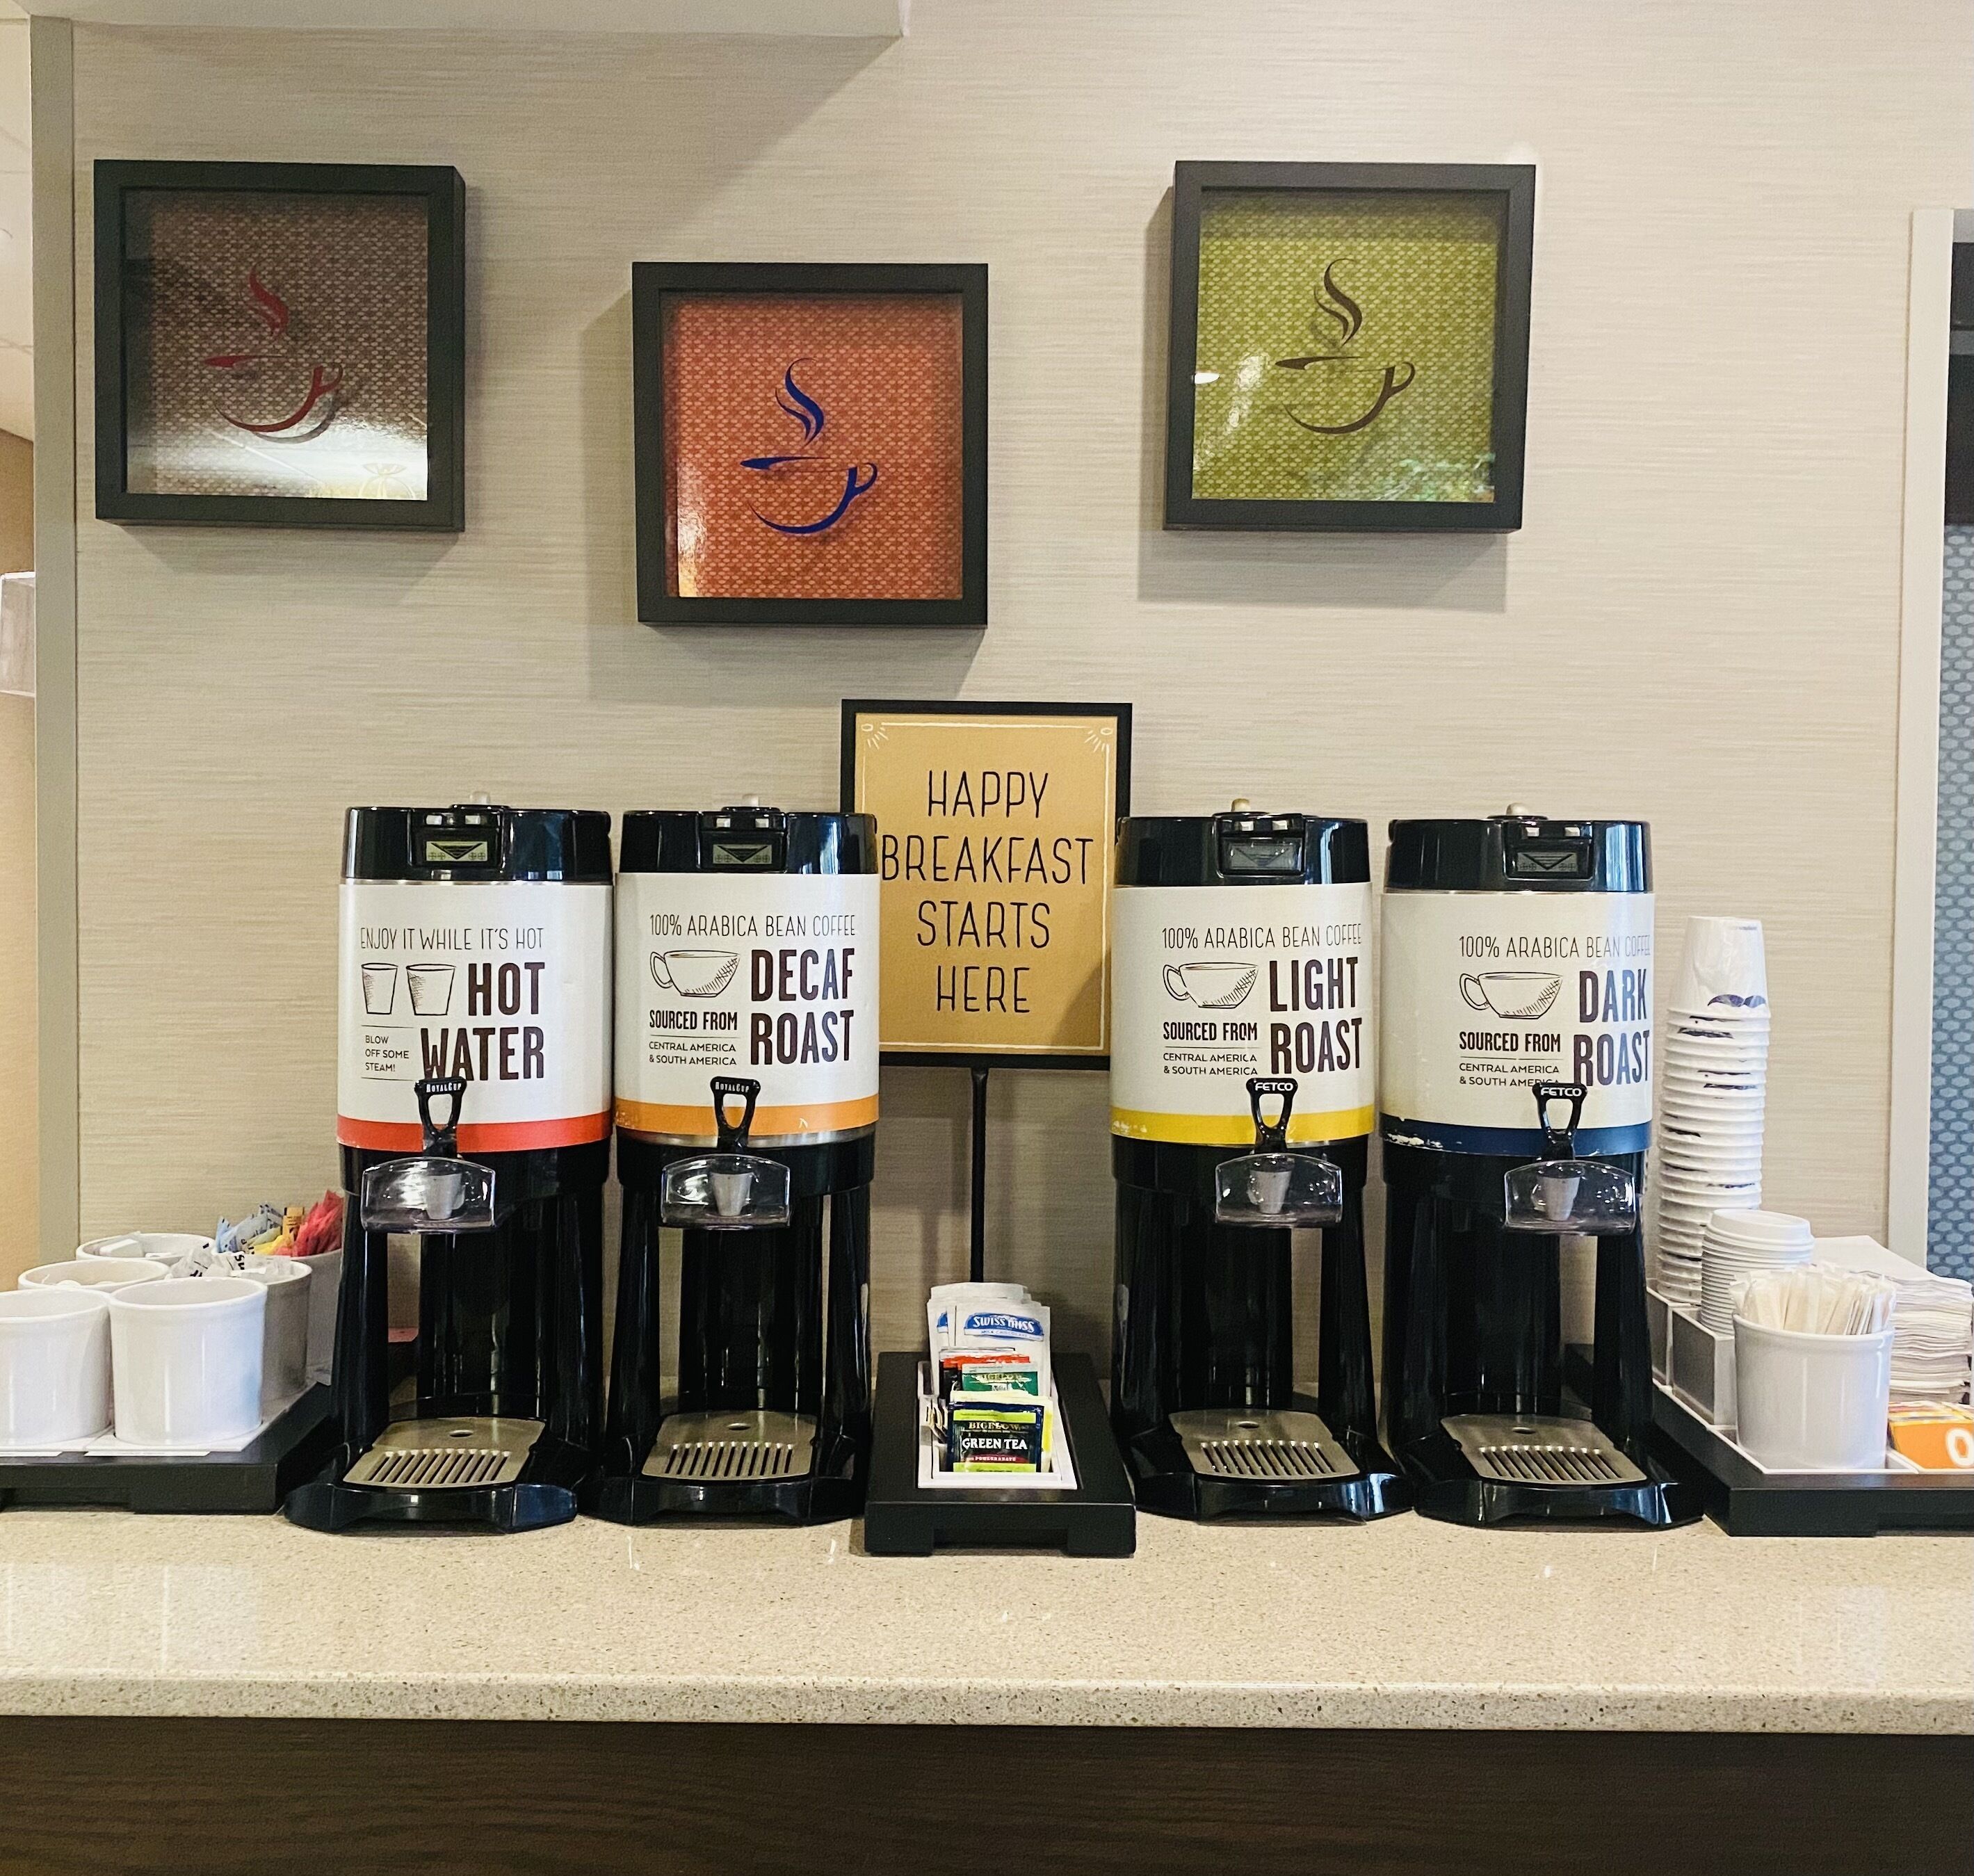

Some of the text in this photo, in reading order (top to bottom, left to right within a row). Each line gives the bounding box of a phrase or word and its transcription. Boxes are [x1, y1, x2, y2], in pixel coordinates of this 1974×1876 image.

[928, 770, 1049, 818] HAPPY
[881, 834, 1094, 884] BREAKFAST
[649, 914, 855, 937] 100% ARABICA BEAN COFFEE
[917, 900, 1051, 948] STARTS
[361, 927, 544, 950] ENJOY IT WHILE IT'S HOT
[1162, 923, 1363, 949] 100% ARABICA BEAN COFFEE
[1459, 935, 1499, 958] 100%
[1506, 936, 1580, 958] ARABICA
[1587, 936, 1620, 957] BEAN
[751, 948, 855, 1002] DECAF
[1269, 956, 1359, 1012] LIGHT
[468, 962, 545, 1017] HOT
[937, 965, 1030, 1013] HERE
[1579, 969, 1647, 1024] DARK
[649, 1010, 738, 1030] SOURCED FROM
[1163, 1021, 1258, 1041] SOURCED FROM
[365, 1035, 389, 1044] BLOW
[649, 1041, 736, 1052] CENTRAL AMERICA
[750, 1009, 854, 1065] ROAST
[1270, 1017, 1362, 1075] ROAST
[1459, 1031, 1561, 1052] SOURCED FROM
[365, 1049, 410, 1059] OFF SOME
[421, 1026, 544, 1081] WATER
[649, 1055, 737, 1066] & SOUTH AMERICA
[1163, 1052, 1257, 1062] CENTRAL AMERICA
[1573, 1029, 1650, 1087] ROAST
[365, 1062, 396, 1072] STEAM!
[1163, 1066, 1258, 1075] & SOUTH AMERICA
[1459, 1062, 1560, 1074] CENTRAL AMERICA
[1254, 1081, 1294, 1092] FETCO
[1459, 1076, 1466, 1085] &
[1469, 1077, 1506, 1086] SOUTH
[1540, 1087, 1583, 1097] FETCO
[973, 1316, 1005, 1327] SWISS
[962, 1438, 1028, 1450] GREEN TEA
